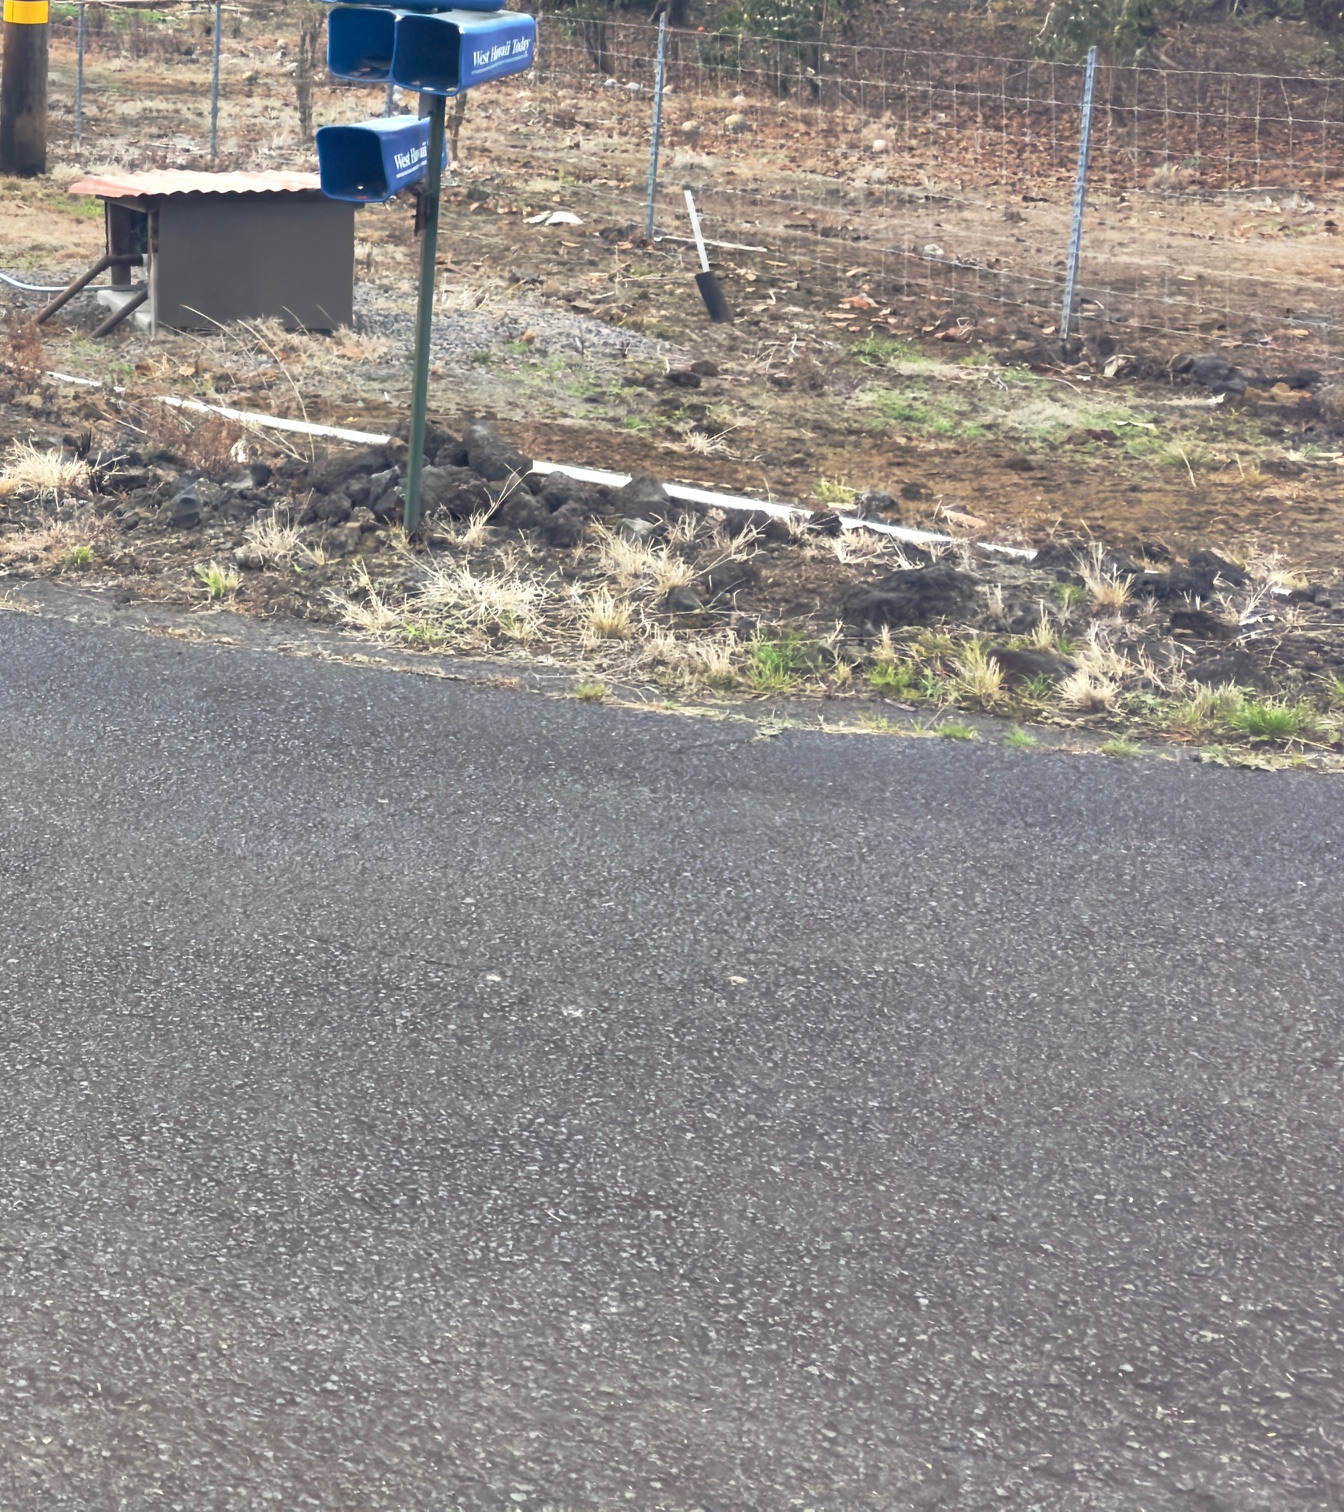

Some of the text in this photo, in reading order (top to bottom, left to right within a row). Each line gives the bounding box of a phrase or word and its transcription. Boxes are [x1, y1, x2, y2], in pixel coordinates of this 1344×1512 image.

[473, 50, 490, 67] West
[512, 36, 531, 55] Today
[394, 151, 410, 170] West
